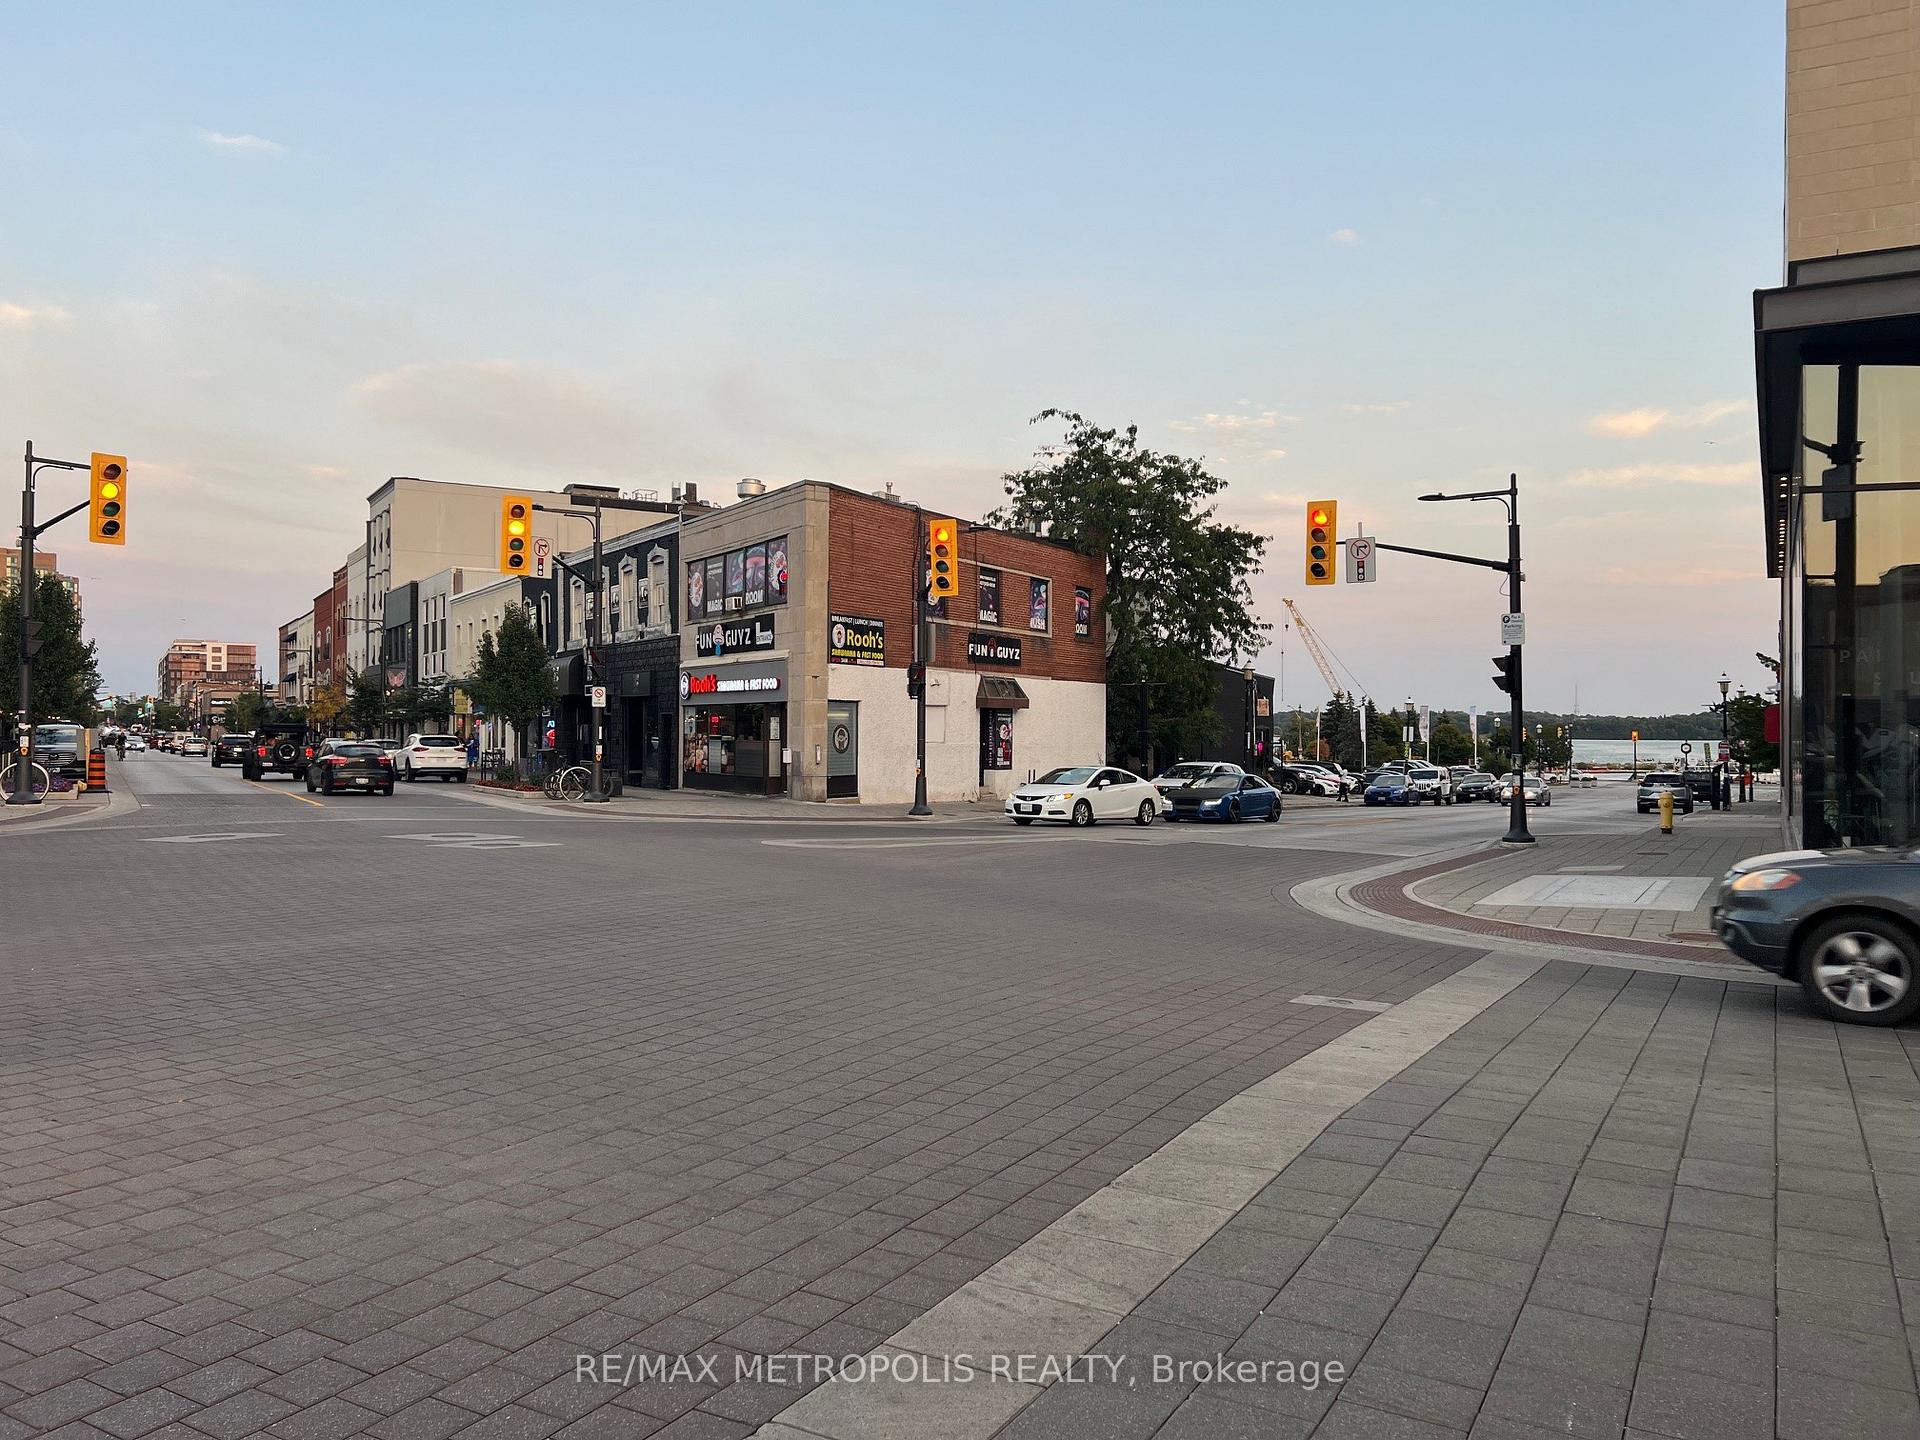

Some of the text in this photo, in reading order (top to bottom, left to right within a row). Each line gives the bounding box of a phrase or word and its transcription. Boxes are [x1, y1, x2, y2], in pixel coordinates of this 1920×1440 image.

[695, 627, 751, 652] FUN GUYZ
[846, 629, 884, 650] Rooh's
[871, 652, 884, 660] FOOD
[968, 643, 1021, 660] FUN GUYZ
[690, 674, 717, 694] Rooh's
[762, 677, 778, 690] FOOD
